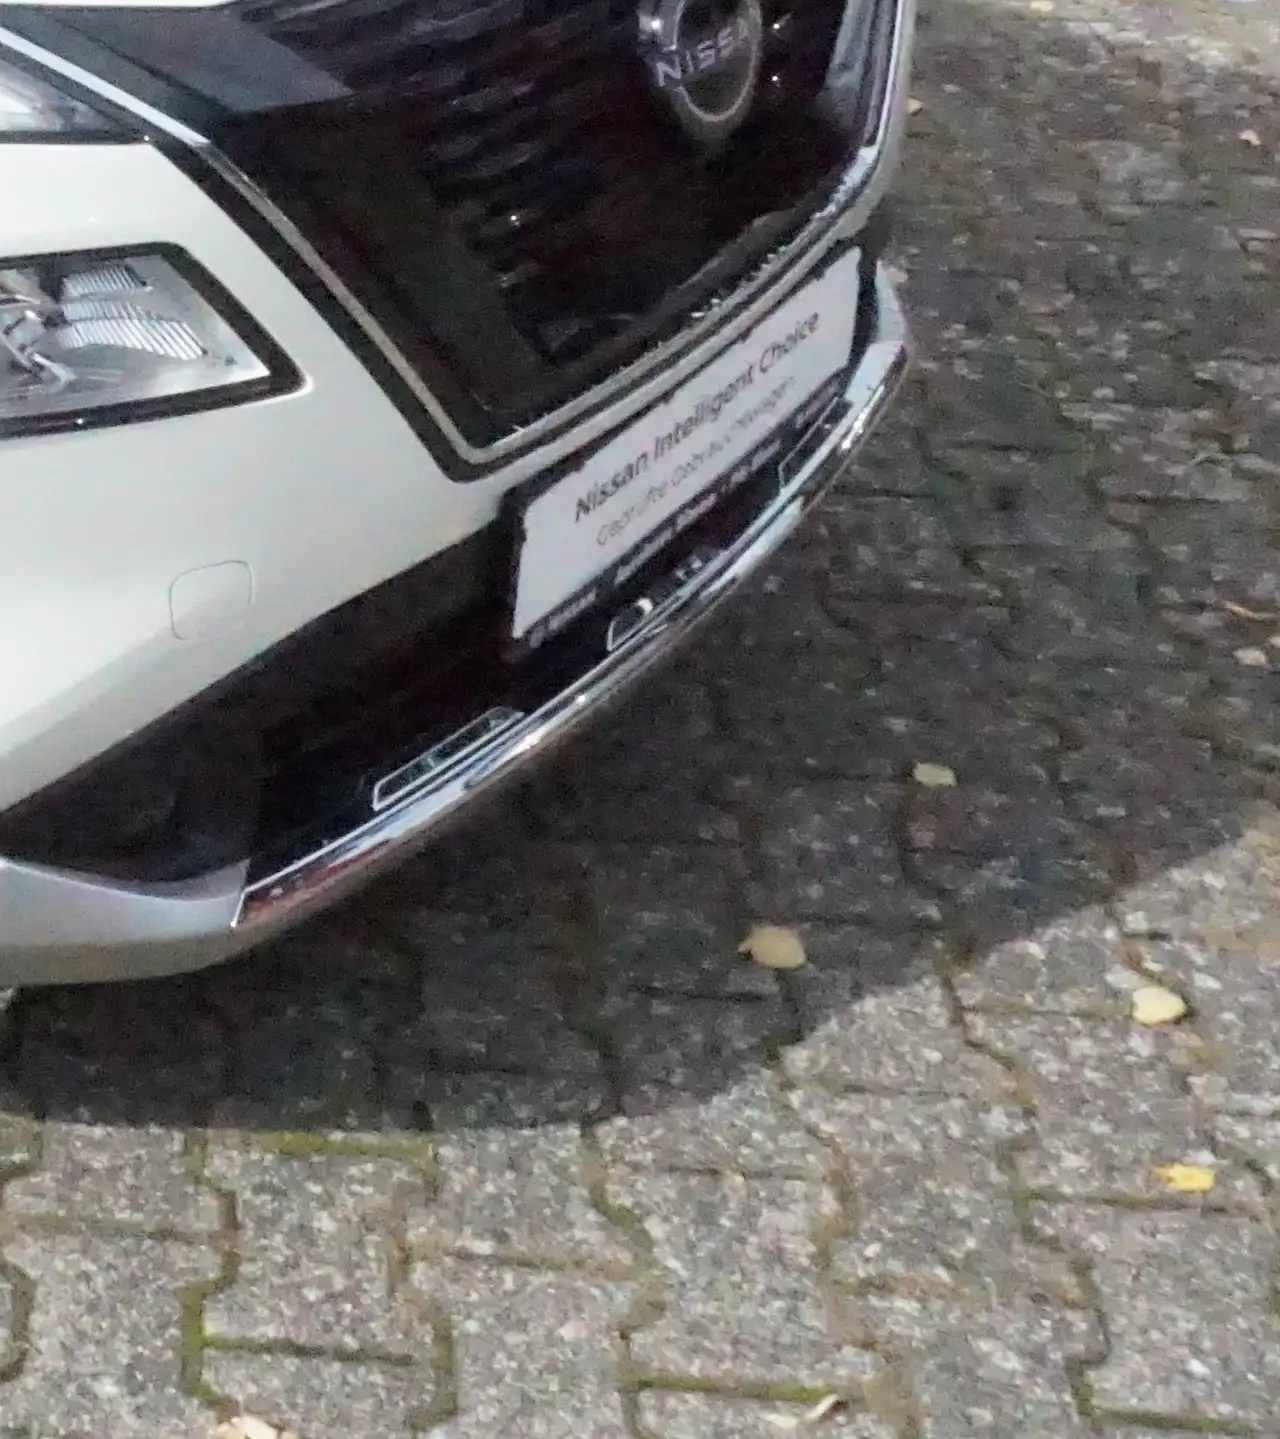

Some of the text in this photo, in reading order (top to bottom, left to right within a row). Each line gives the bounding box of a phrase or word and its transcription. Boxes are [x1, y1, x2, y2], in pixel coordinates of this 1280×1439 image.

[574, 450, 649, 523] Nissan
[652, 363, 755, 462] Intelligent
[759, 311, 819, 374] Choice
